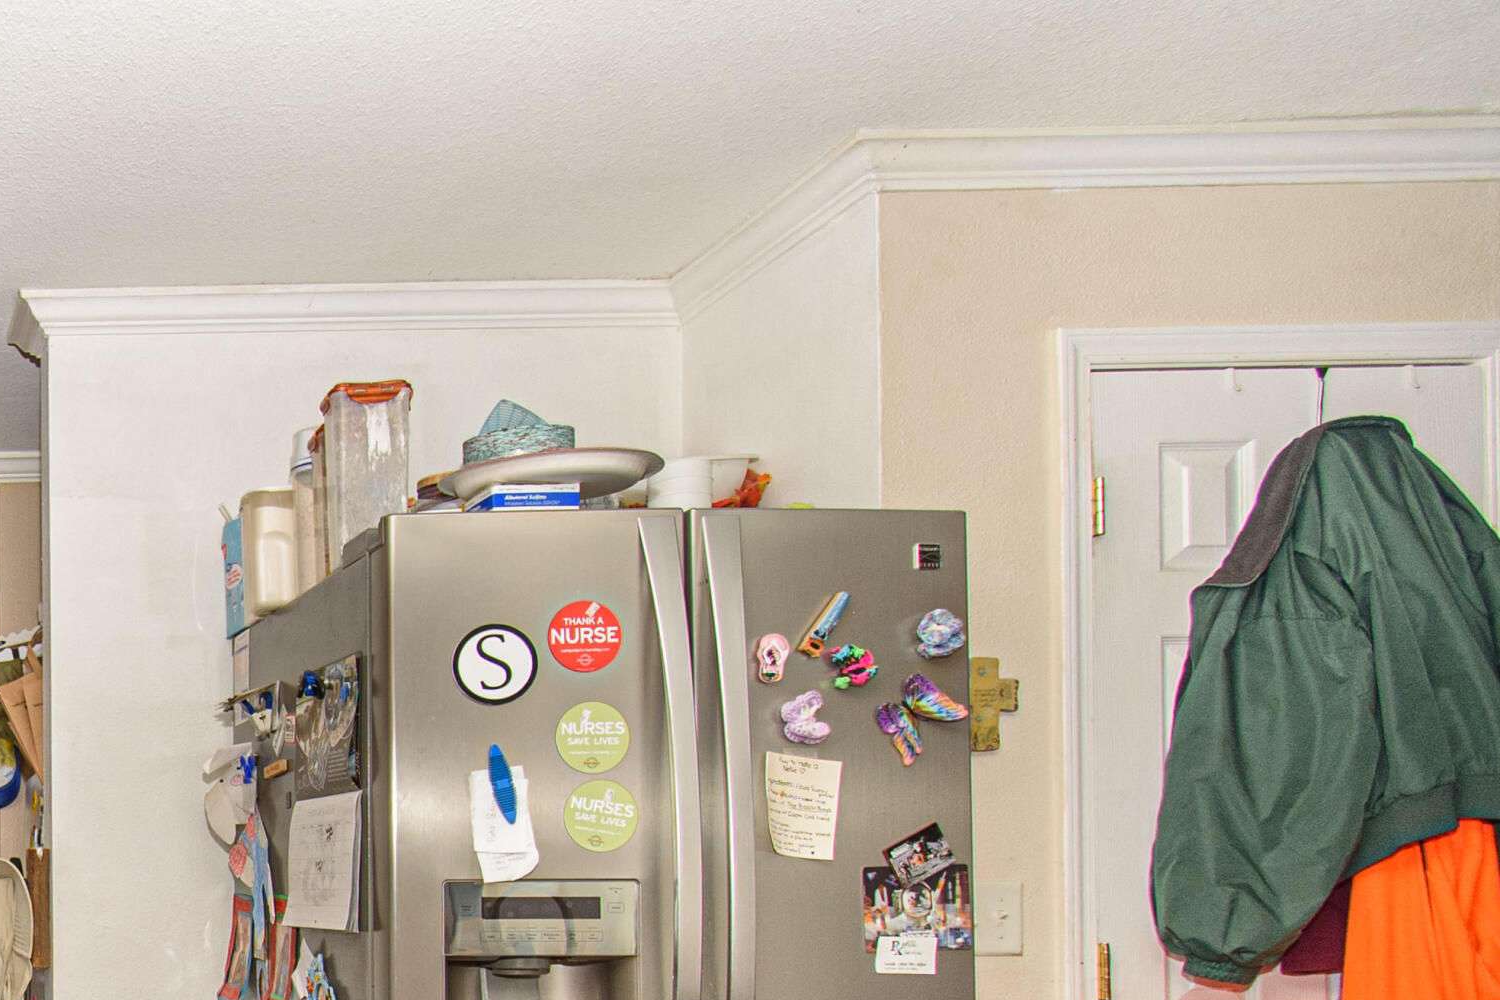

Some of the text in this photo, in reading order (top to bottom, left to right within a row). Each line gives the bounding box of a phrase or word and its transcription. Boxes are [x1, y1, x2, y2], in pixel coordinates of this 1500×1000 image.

[563, 616, 604, 626] THANK A
[550, 626, 619, 645] NURSE
[476, 634, 513, 690] S
[561, 720, 626, 736] NURSES
[567, 736, 620, 746] SAVE LIVES
[570, 796, 634, 818] NURSES
[574, 811, 627, 828] SAVE LIVES
